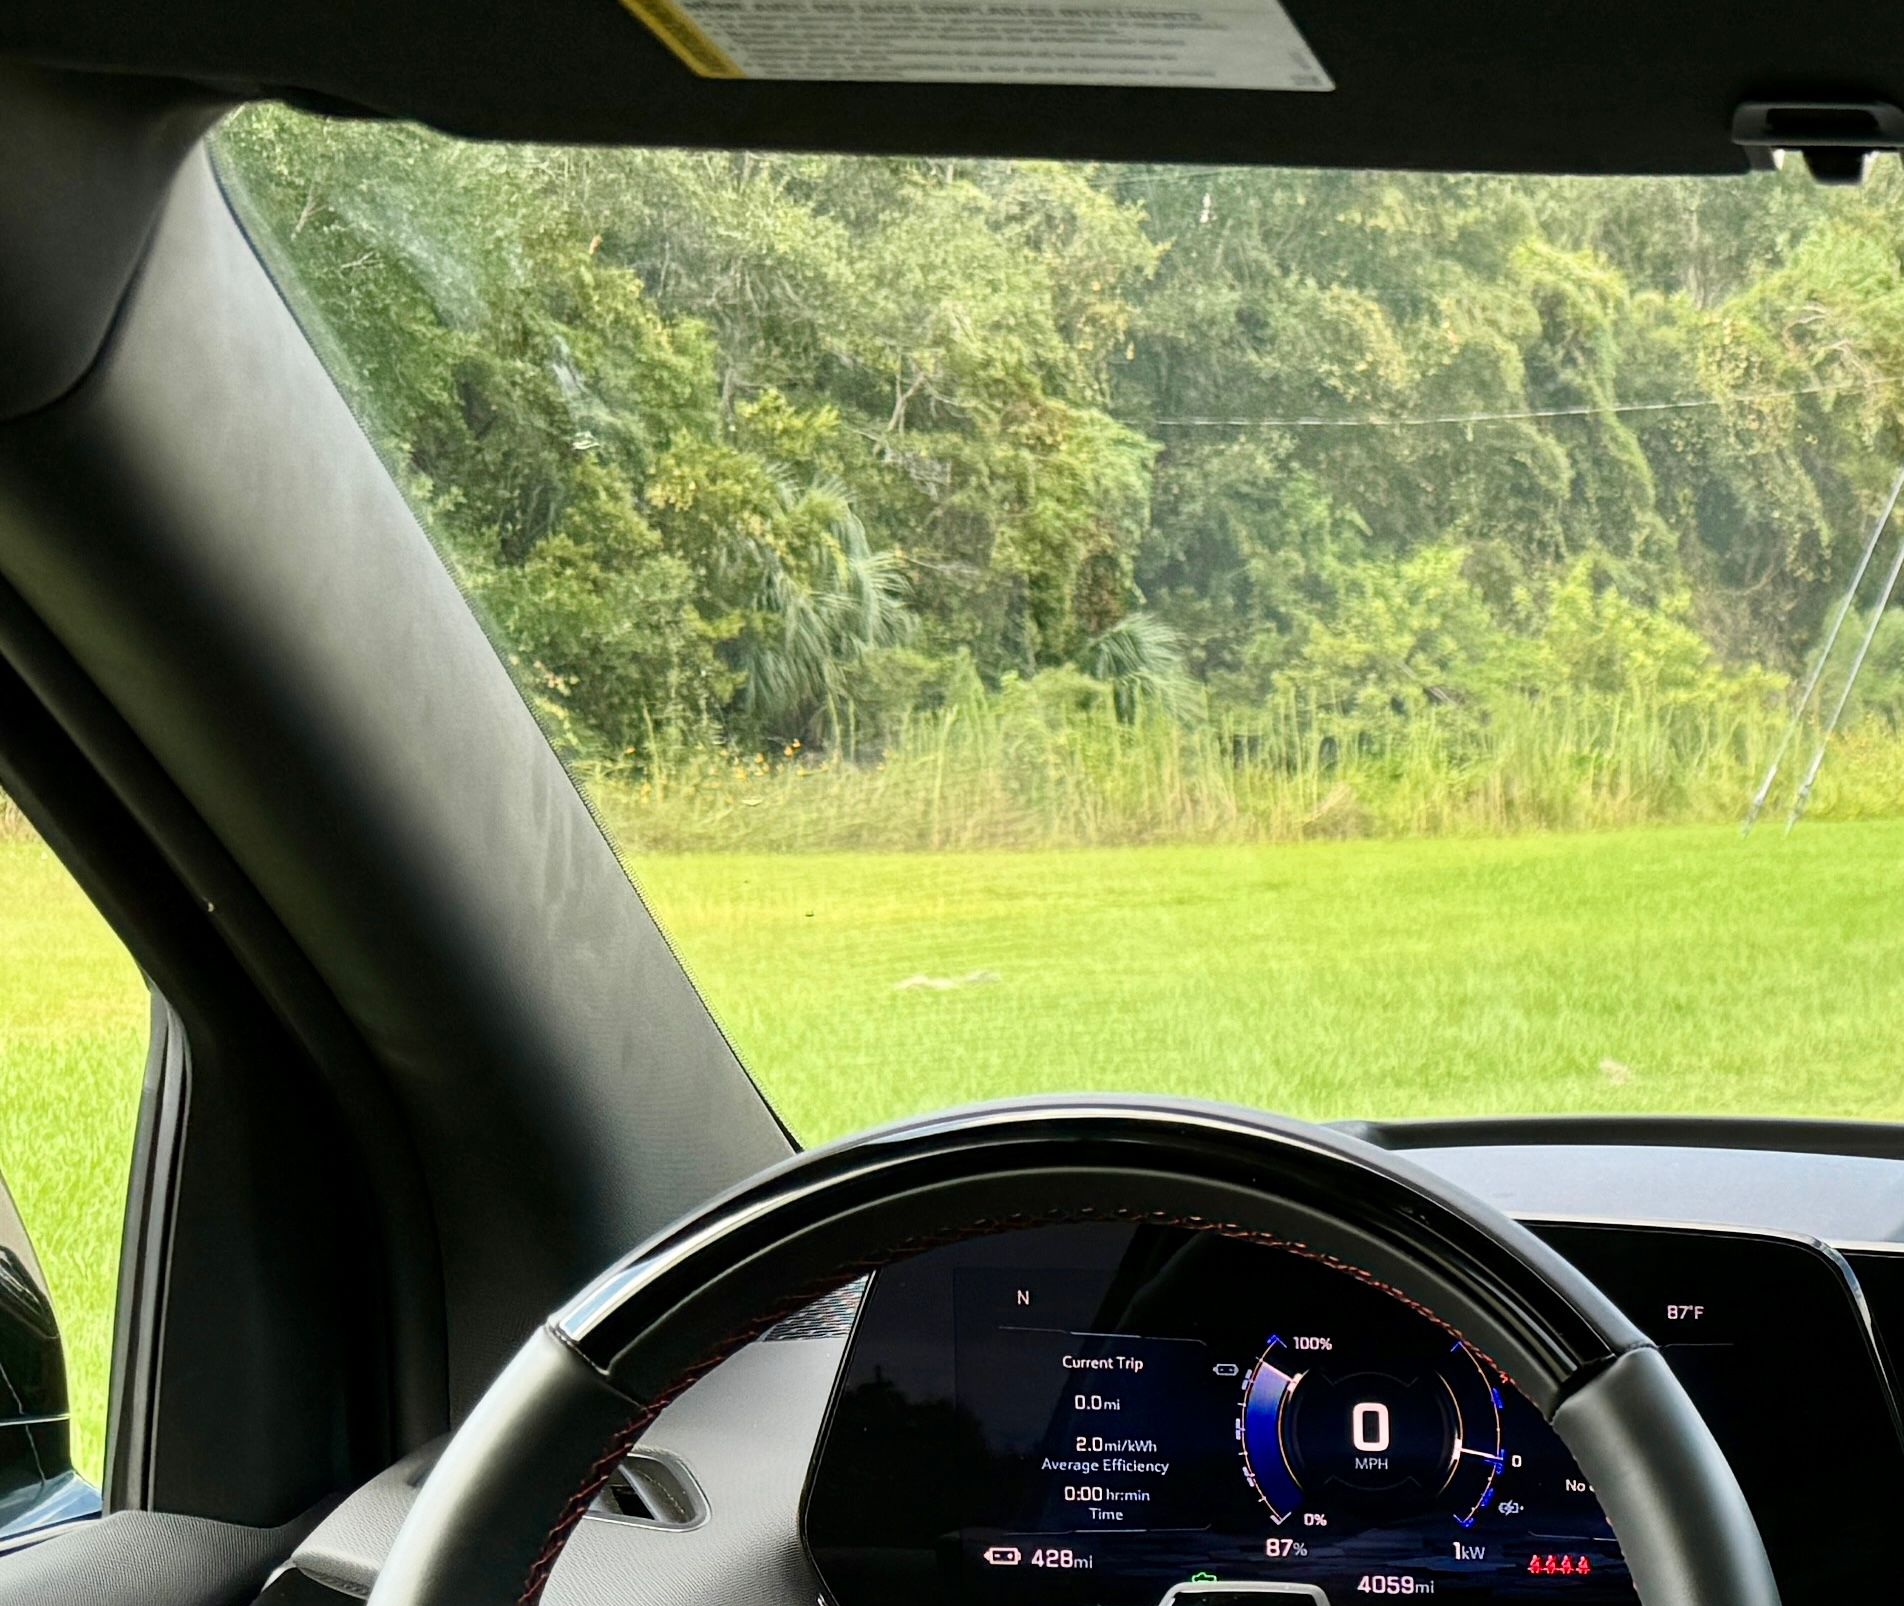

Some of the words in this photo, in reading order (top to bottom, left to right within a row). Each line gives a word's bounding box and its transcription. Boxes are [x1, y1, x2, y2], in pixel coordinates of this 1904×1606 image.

[1017, 1289, 1030, 1305] N
[1293, 1336, 1333, 1351] 100%
[1062, 1355, 1114, 1370] Current
[1115, 1356, 1144, 1373] Trip
[1352, 1402, 1390, 1452] 0
[1041, 1457, 1100, 1475] Average
[1102, 1457, 1170, 1476] Efficiency
[1355, 1457, 1389, 1470] MPH
[1511, 1454, 1522, 1468] 0
[1565, 1478, 1586, 1492] No
[1064, 1485, 1103, 1502] 0:00
[1105, 1488, 1151, 1502] hr:min
[1088, 1507, 1124, 1521] Time
[1303, 1512, 1328, 1527] 0%
[1265, 1537, 1308, 1557] 87%
